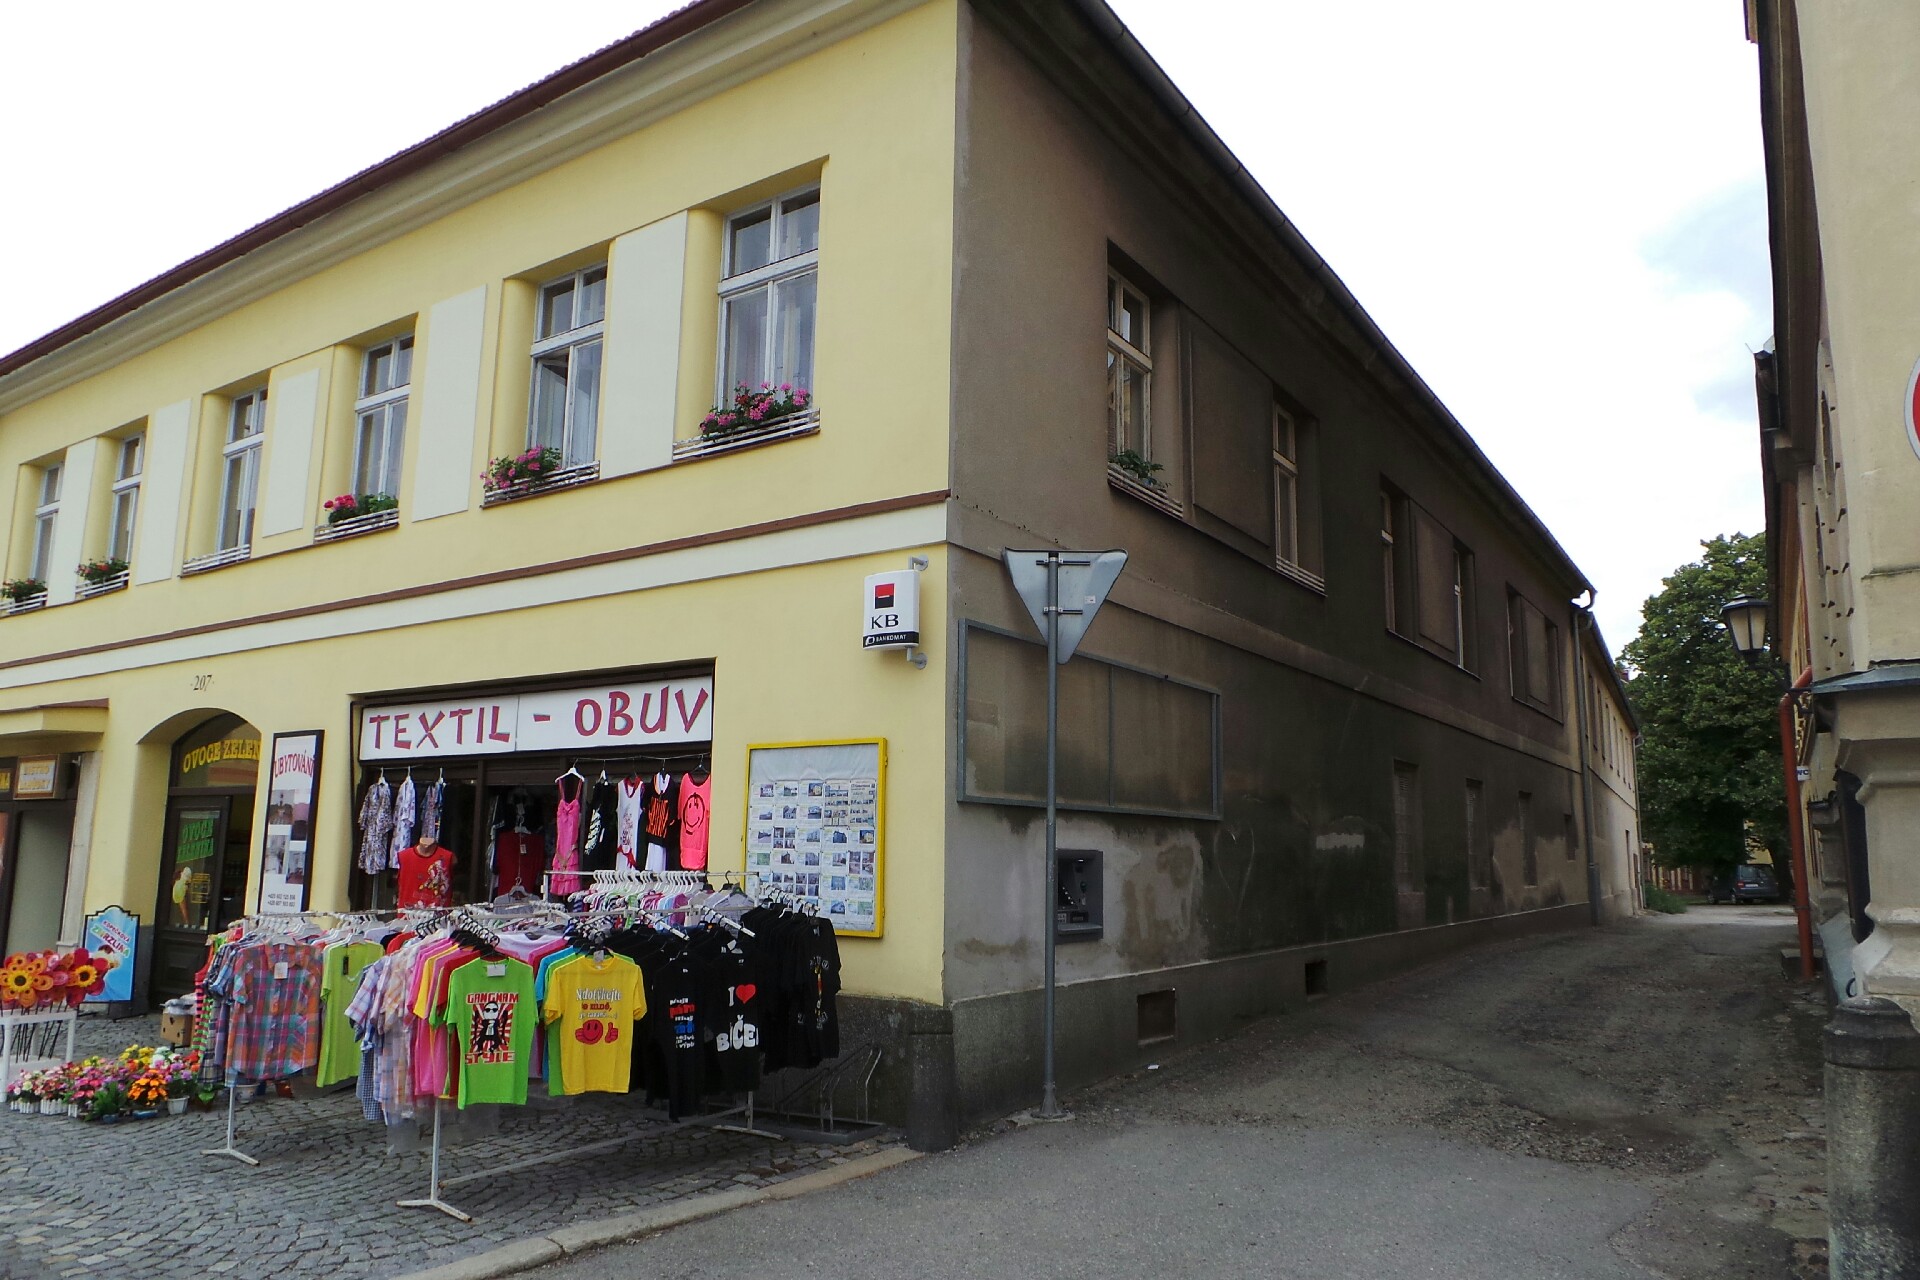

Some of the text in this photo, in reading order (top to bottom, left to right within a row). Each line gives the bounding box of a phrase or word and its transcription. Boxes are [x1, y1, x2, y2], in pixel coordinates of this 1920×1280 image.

[871, 614, 899, 629] KB
[876, 634, 907, 642] BANKOMAT
[369, 705, 511, 750] TEXTIL
[574, 685, 709, 737] OBUV
[183, 740, 221, 774] OVOCE
[466, 992, 519, 1004] GANGNAM
[727, 986, 735, 1007] I
[465, 1051, 516, 1065] STYLE
